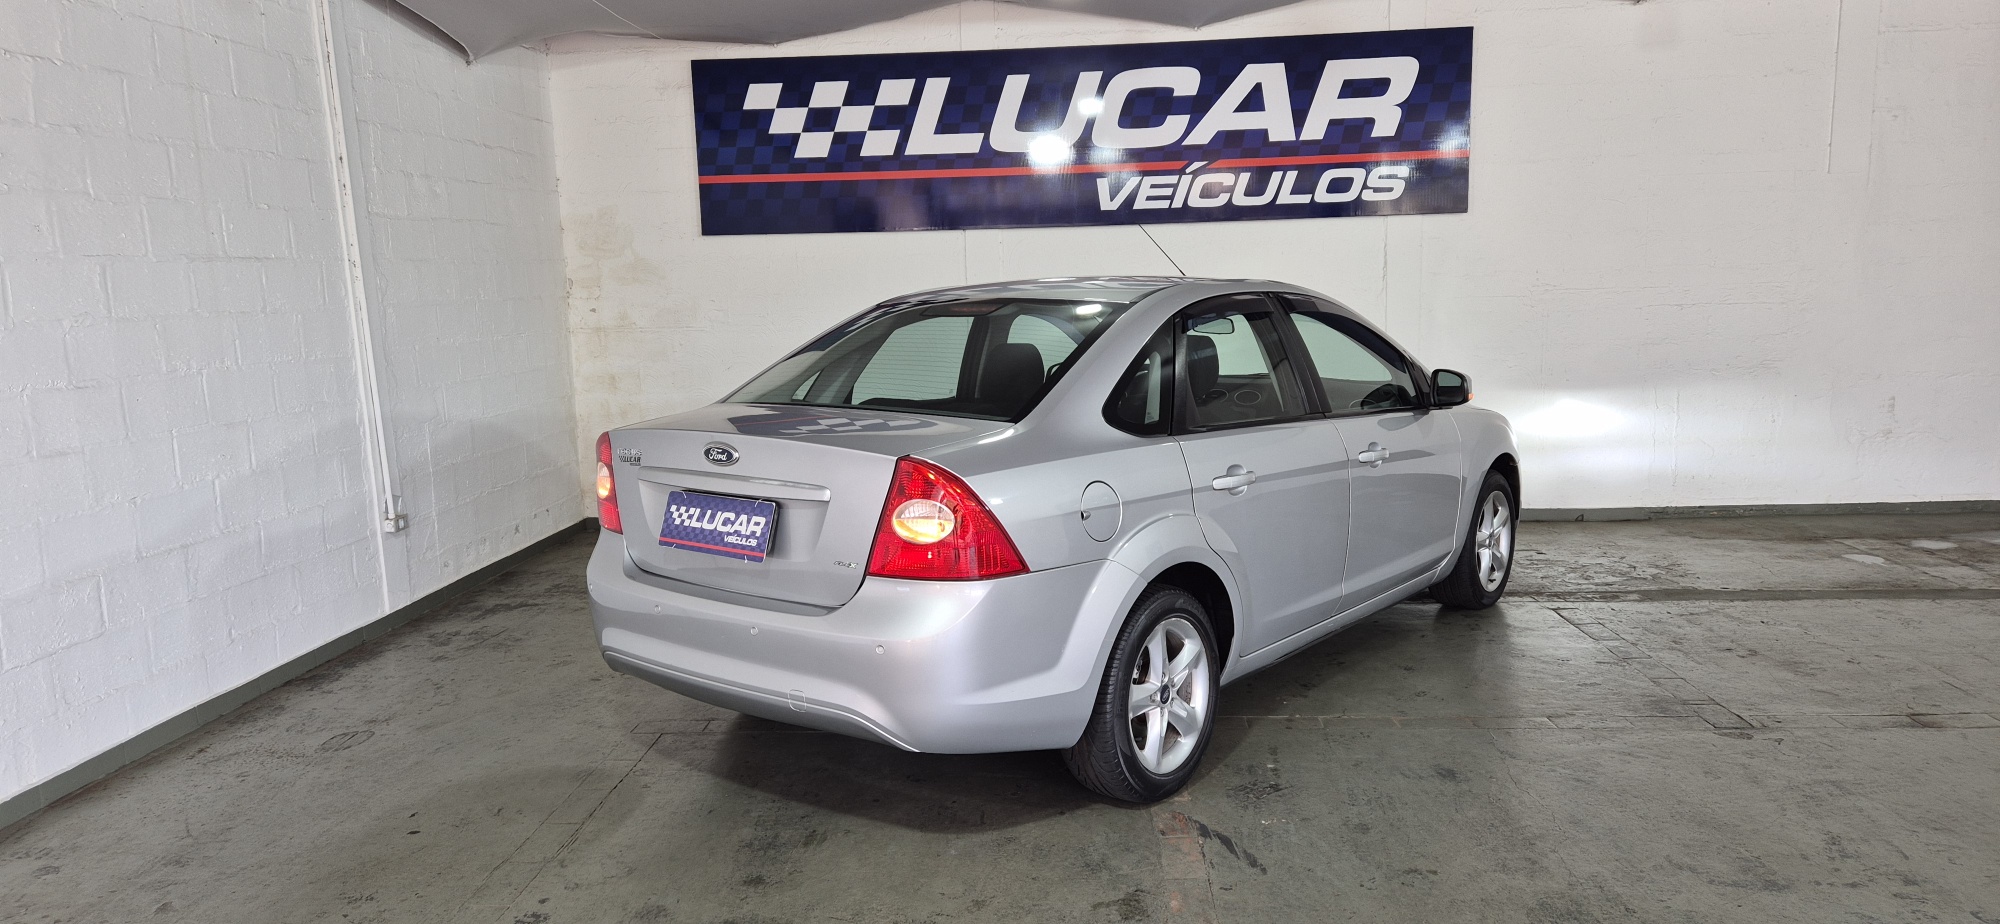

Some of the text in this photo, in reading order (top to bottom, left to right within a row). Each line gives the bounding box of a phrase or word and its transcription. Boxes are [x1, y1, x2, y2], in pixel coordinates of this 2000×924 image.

[904, 56, 1419, 157] LUCAR
[1096, 162, 1410, 212] VEÍCULOS
[708, 447, 728, 461] Ford
[690, 508, 766, 537] LUCAR
[724, 534, 758, 547] VEÍCULOS
